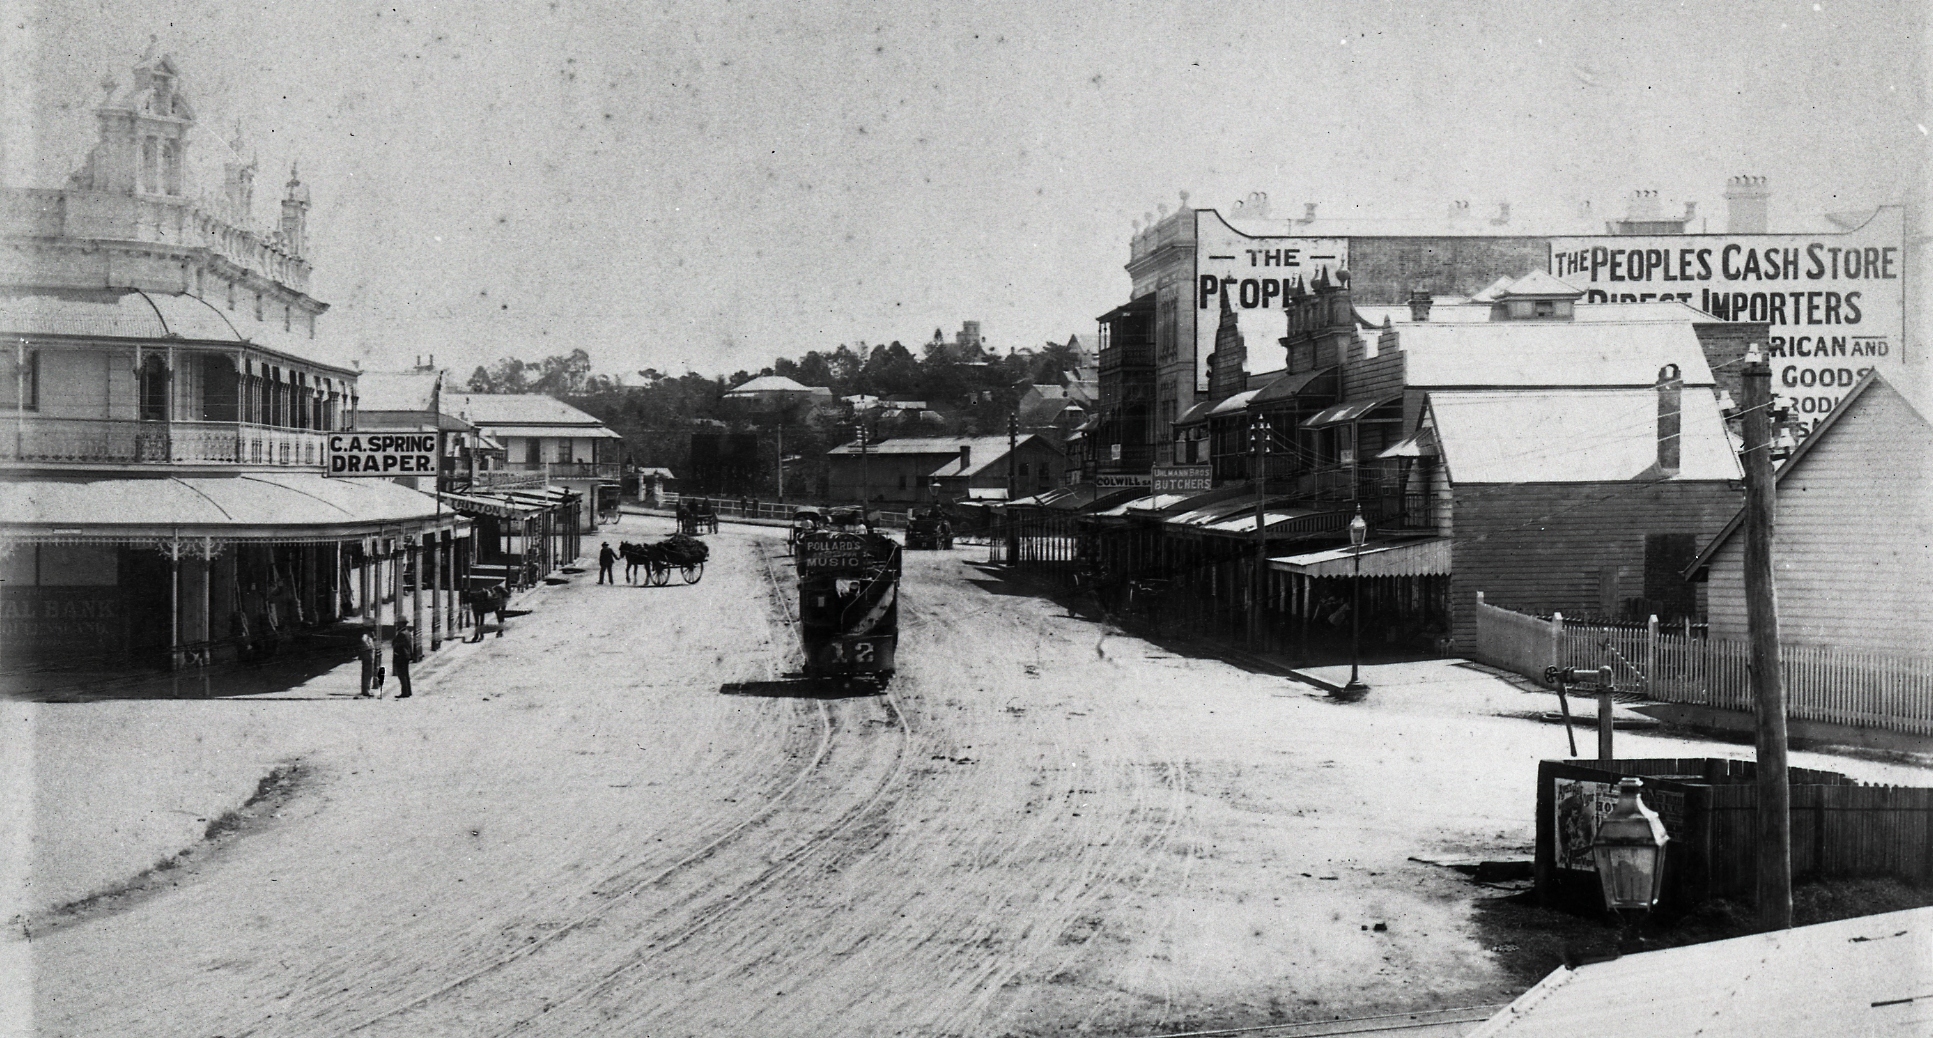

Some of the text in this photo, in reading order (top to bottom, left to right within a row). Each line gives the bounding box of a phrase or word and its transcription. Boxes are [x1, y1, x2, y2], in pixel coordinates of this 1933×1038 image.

[1246, 249, 1300, 267] THE
[1555, 243, 1898, 282] THE PEOPLES CASH STORE
[1702, 288, 1862, 326] IMPORTERS
[1851, 341, 1889, 356] AND
[332, 455, 435, 472] DRAPER.
[1154, 479, 1212, 490] BUTCHERS
[807, 541, 861, 551] POLLARD'S
[44, 600, 116, 618] BANK
